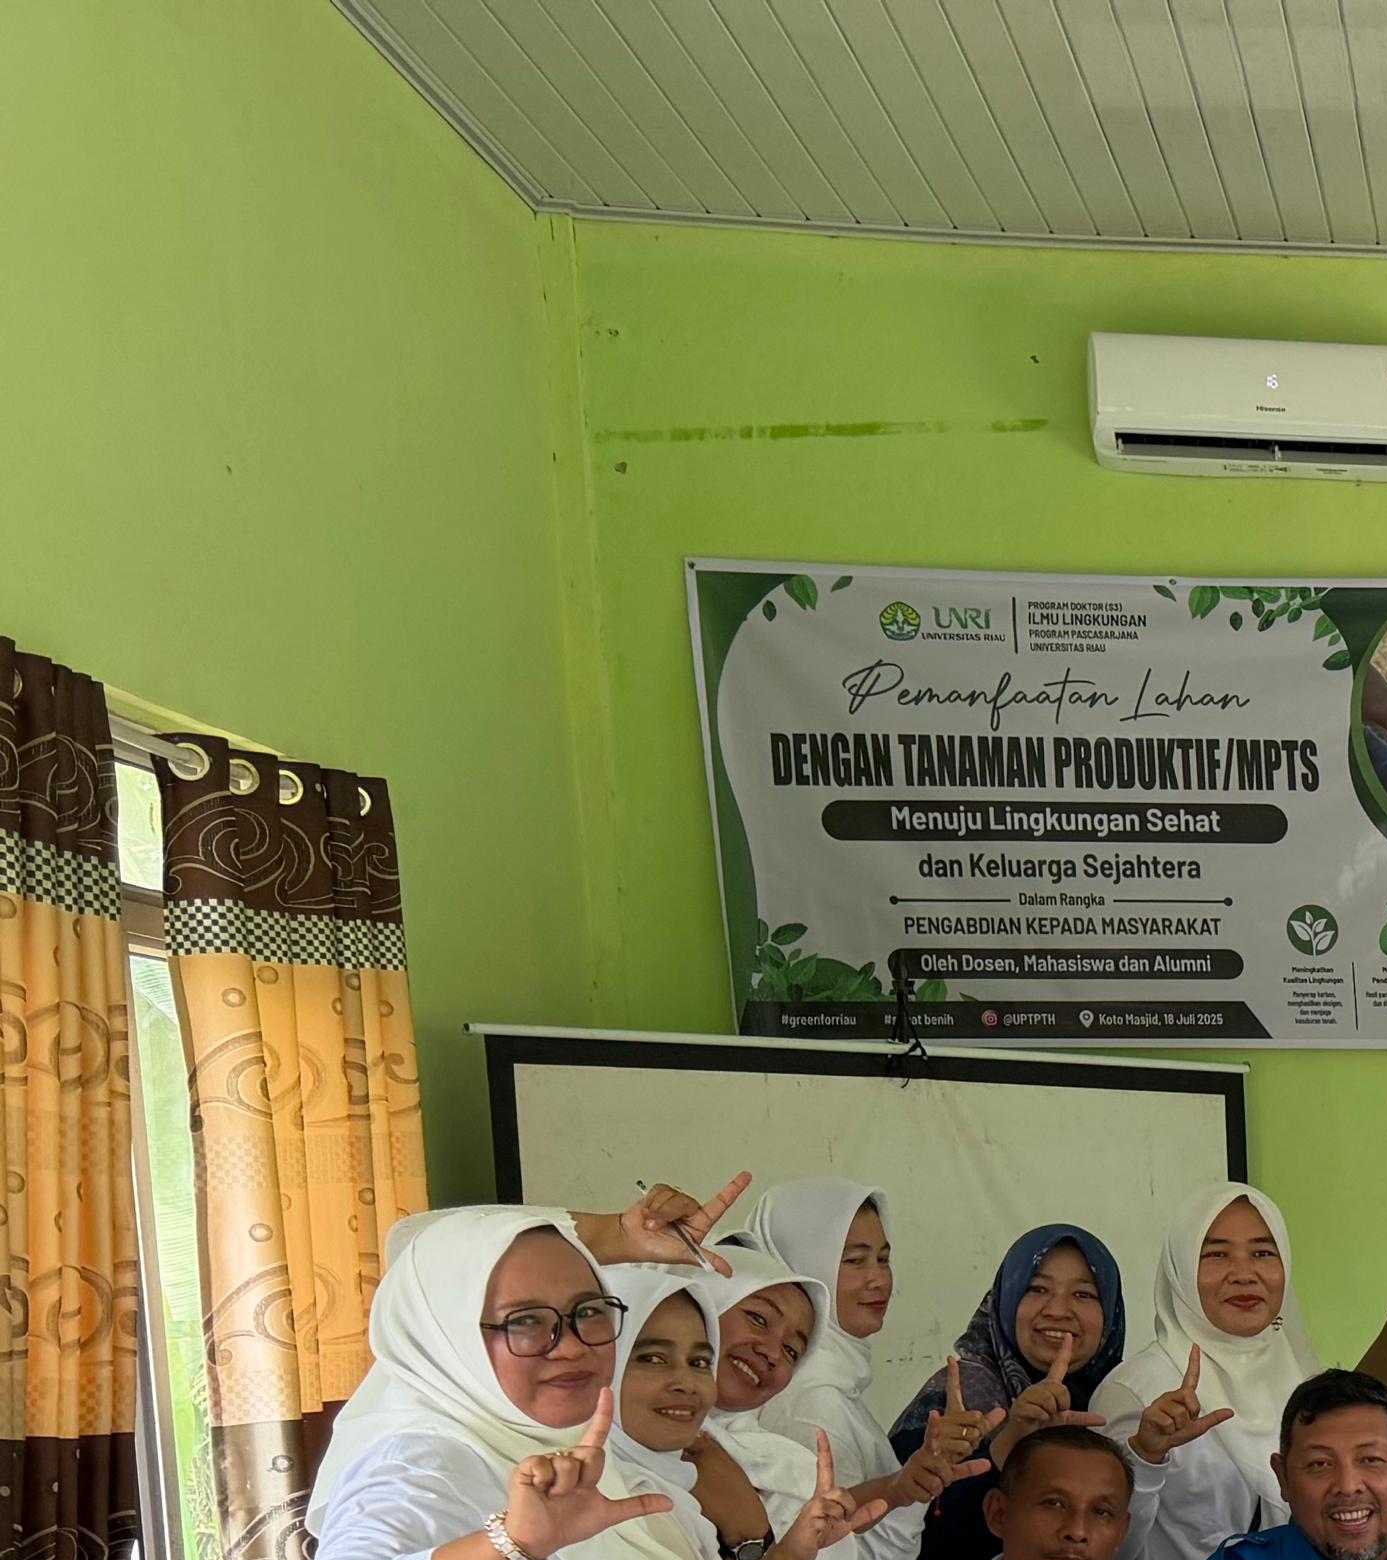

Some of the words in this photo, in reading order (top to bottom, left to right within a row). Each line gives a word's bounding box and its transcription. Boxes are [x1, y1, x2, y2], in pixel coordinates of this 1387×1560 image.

[1028, 601, 1069, 610] PROGRAM
[1070, 602, 1104, 611] DOKTOR
[1105, 602, 1122, 612] (S3)
[933, 606, 992, 629] UNRI
[1028, 612, 1059, 626] ILMU
[1063, 613, 1147, 627] LINGKUNGAN
[921, 632, 981, 641] UNIVERSITAS
[983, 633, 1006, 642] RIAU
[1029, 629, 1070, 639] PROGRAM
[1072, 630, 1139, 640] PASCASARJANA
[1030, 642, 1084, 652] UNIVERSITAS
[1086, 643, 1106, 652] RIAU
[842, 659, 1119, 731] Pemanfaatan
[1119, 667, 1251, 723] Lahan
[770, 733, 894, 787] DENGAN
[898, 734, 1046, 789] TANAMAN
[1054, 736, 1320, 792] PRODUKTIF/MPTS
[891, 806, 982, 833] Menuju
[989, 807, 1140, 837] Lingkungan
[1146, 808, 1221, 834] Sehat
[918, 853, 964, 879] dan
[970, 854, 1077, 885] Keluarga
[1083, 855, 1201, 884] Sejahtera
[1018, 893, 1056, 906] Dalam
[1059, 894, 1105, 909] Rangka
[904, 917, 1022, 936] PENGABDIAN
[1026, 918, 1098, 936] KEPADA
[1102, 918, 1222, 936] MASYARAKAT
[920, 954, 958, 972] Oleh
[962, 955, 1020, 975] Dosen,
[1024, 955, 1115, 973] Mahasiswa
[1118, 955, 1150, 972] dan
[1154, 955, 1211, 973] Alumni
[780, 1014, 856, 1028] #greenforriau
[924, 1014, 954, 1025] benih
[1003, 1012, 1056, 1026] @UPTPTH
[1099, 1013, 1123, 1026] Koto
[1125, 1013, 1162, 1027] Masjid,
[1164, 1013, 1174, 1025] 18
[1176, 1013, 1195, 1026] Juli
[1197, 1013, 1224, 1026] 2025
